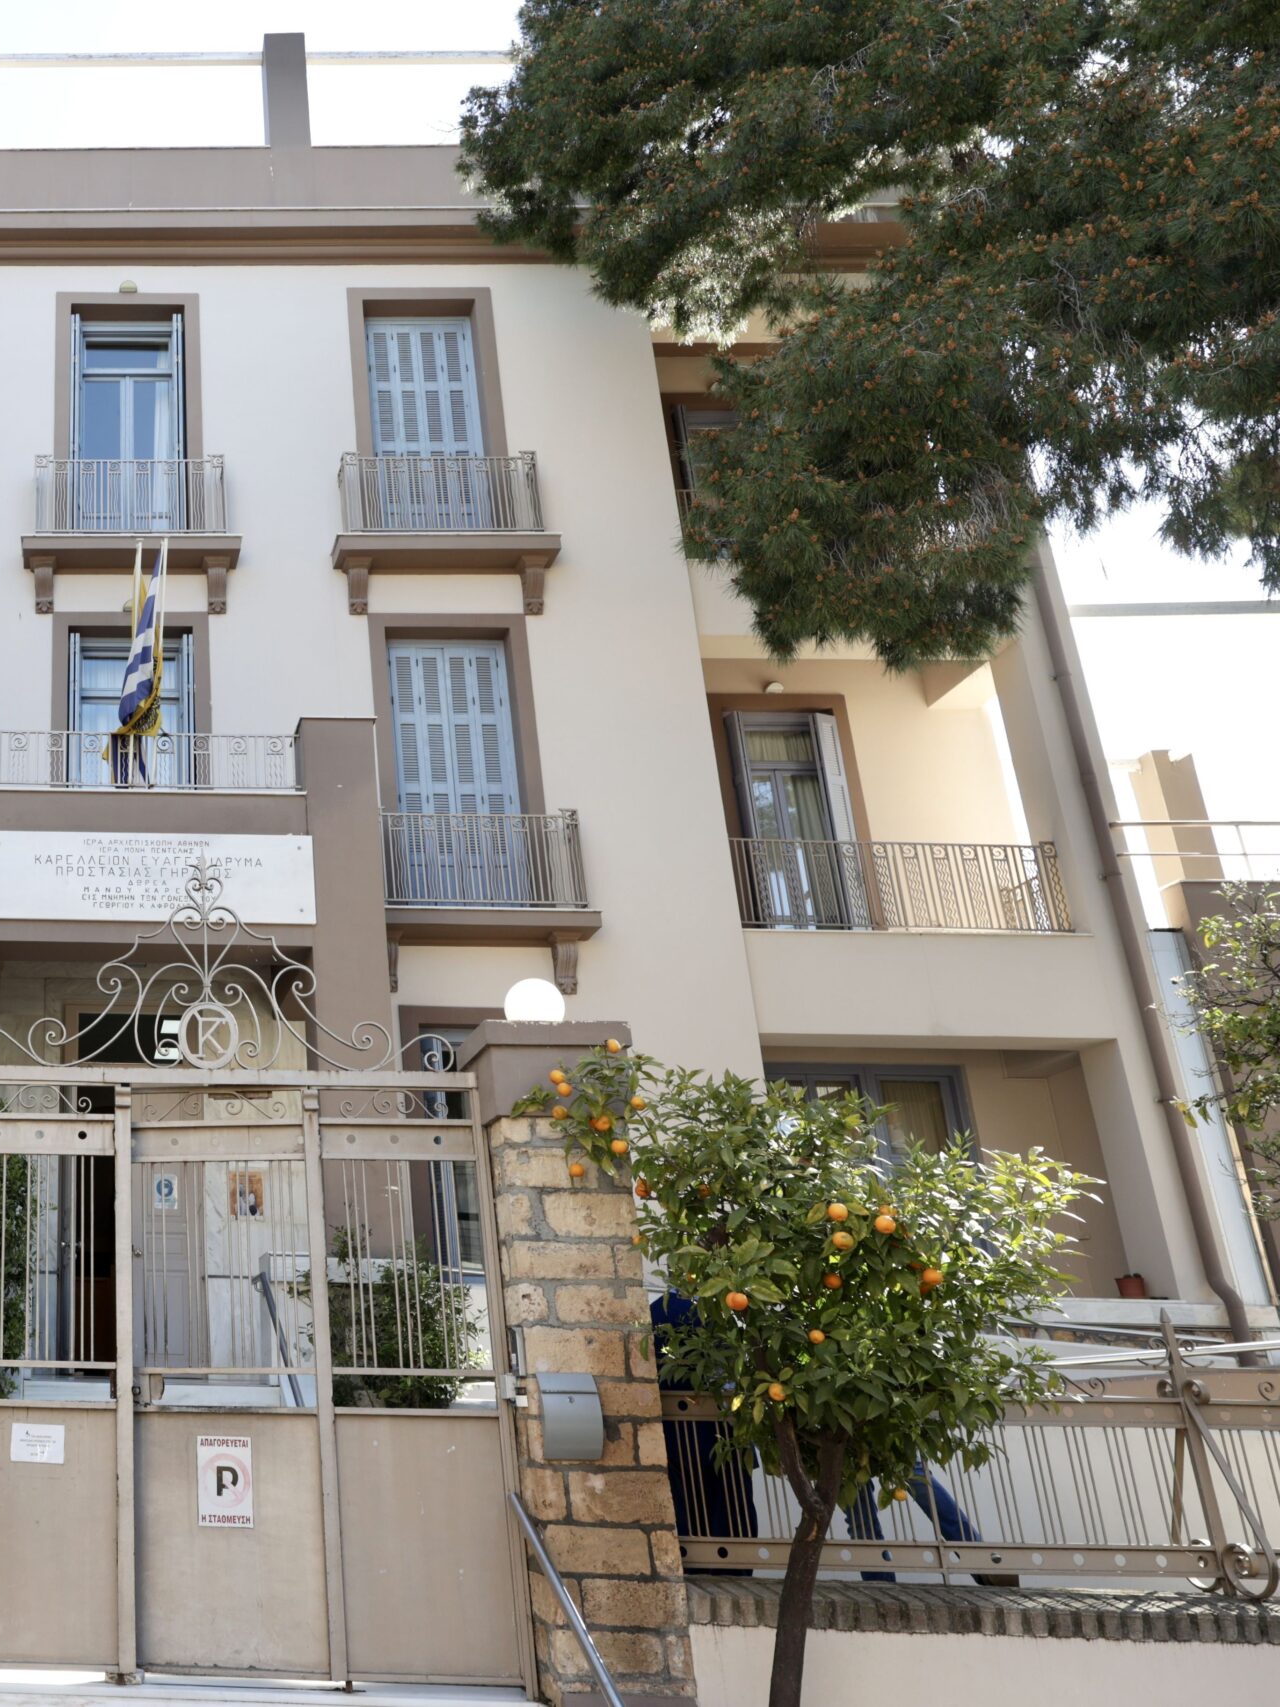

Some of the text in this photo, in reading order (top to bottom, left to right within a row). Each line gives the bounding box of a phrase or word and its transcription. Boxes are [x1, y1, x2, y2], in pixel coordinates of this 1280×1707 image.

[34, 854, 130, 866] ΚΑΡΕΛΛΕΙΟΝ
[55, 866, 233, 879] ΠΡΟΣΤΑΣΙΑΣ ΓΗΡΑΟΣ
[200, 1438, 249, 1448] ΑΠΑΓΟΡΕΥΕΤΑΙ
[201, 1514, 251, 1525] Η ΣΤΑΘΜΕΥΣΗ
